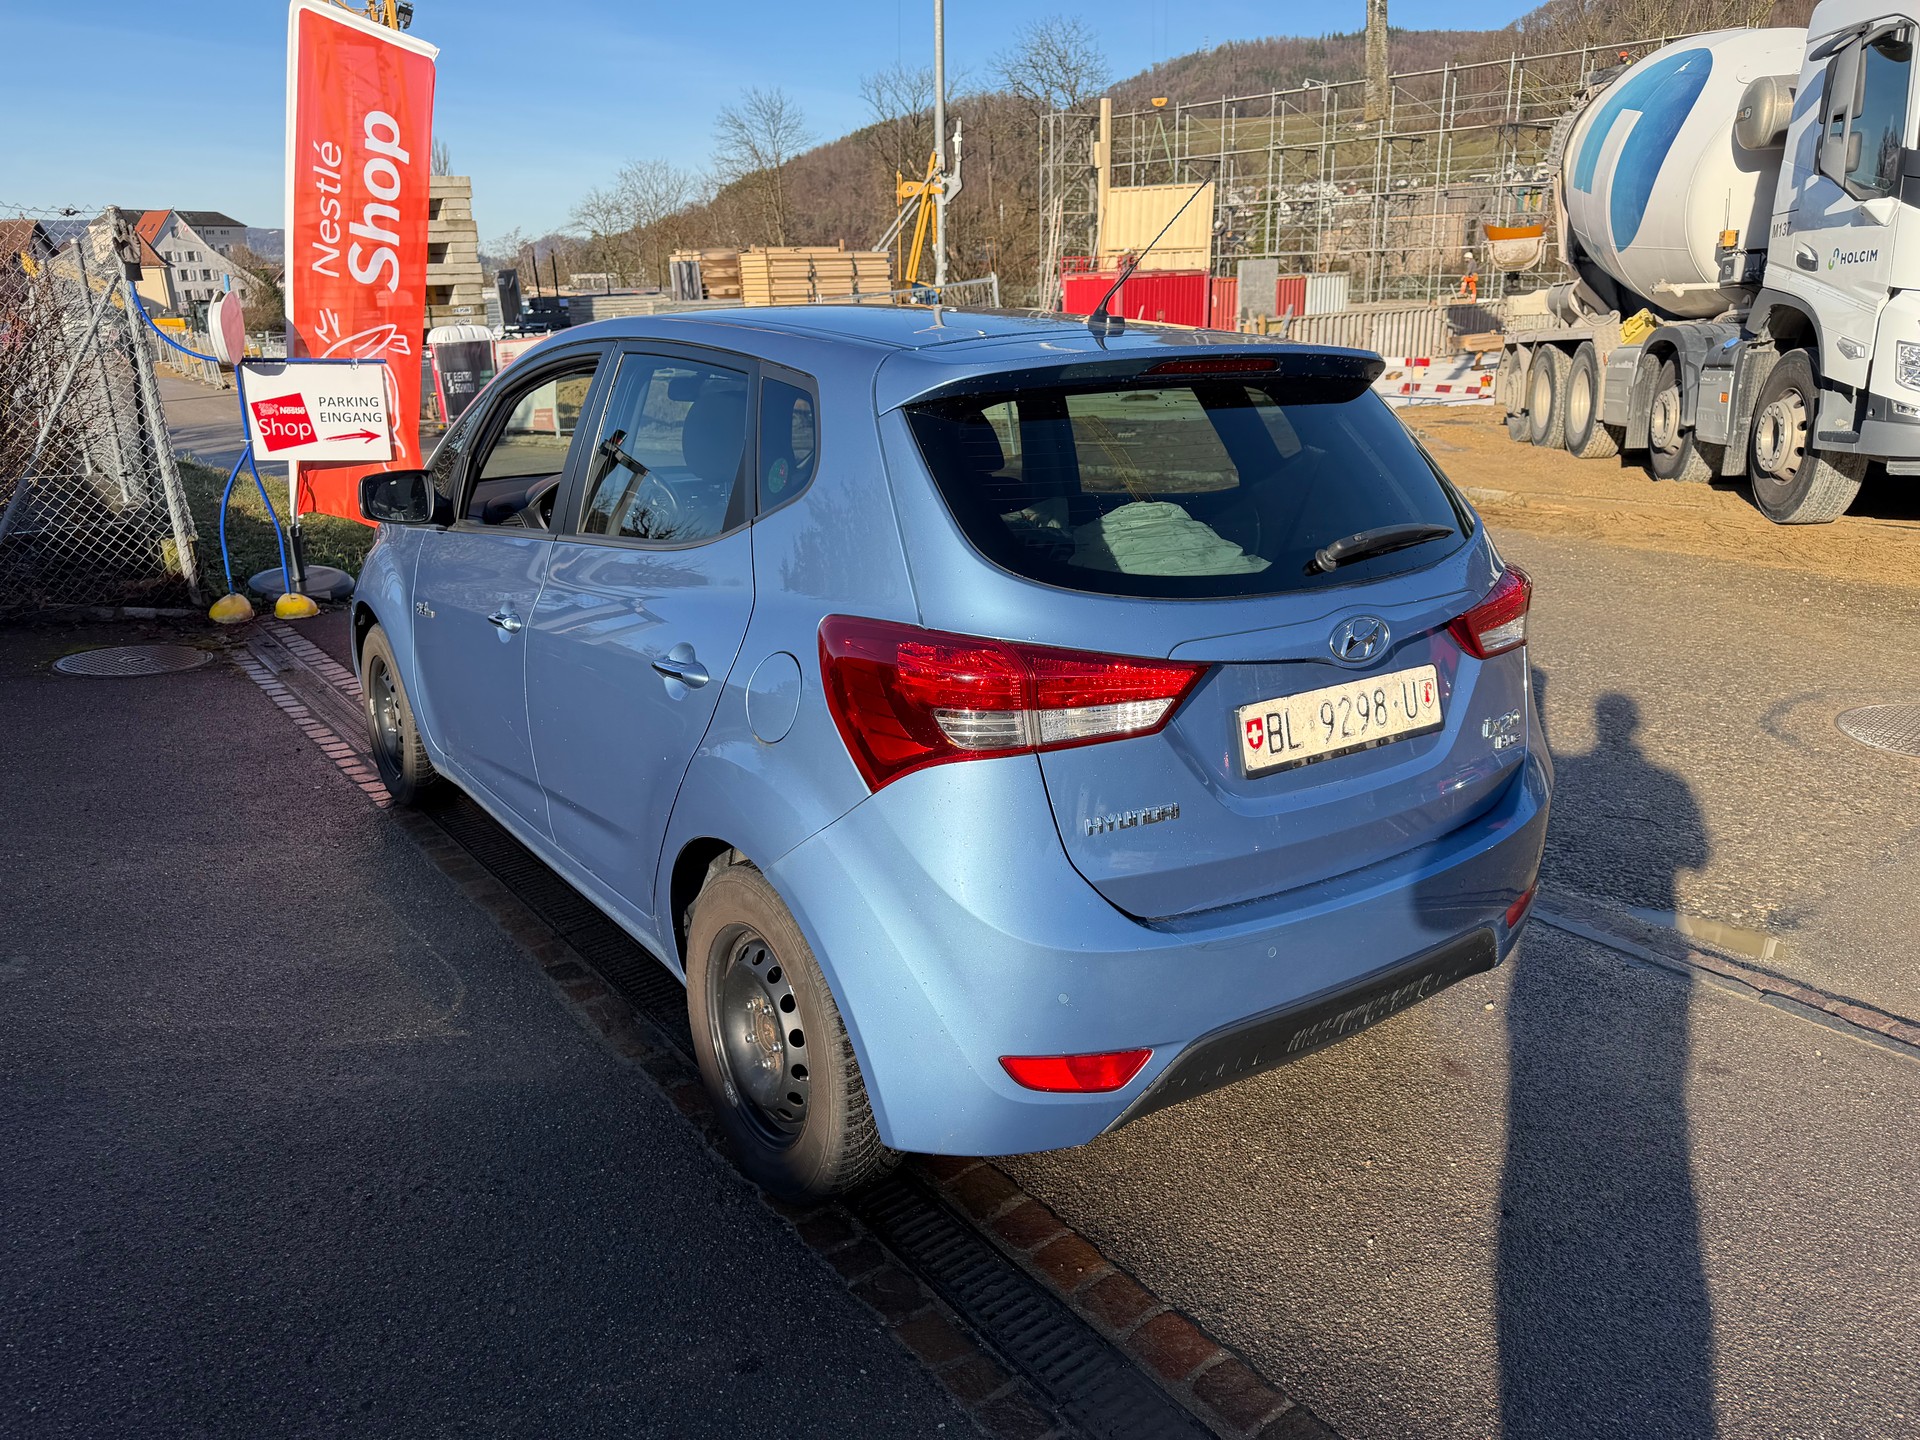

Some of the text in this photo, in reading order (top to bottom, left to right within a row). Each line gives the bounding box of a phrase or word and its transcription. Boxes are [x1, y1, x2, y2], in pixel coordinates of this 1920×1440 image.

[312, 140, 342, 278] Nestlé
[347, 110, 410, 294] Shop
[1771, 221, 1792, 239] M137
[1840, 249, 1879, 265] HOLCIM
[318, 396, 379, 408] PARKING
[258, 417, 312, 441] Shop
[320, 412, 382, 423] EINGANG
[1266, 707, 1304, 755] BL
[1320, 687, 1389, 745] 9298
[1084, 802, 1180, 837] HYUNDAI
